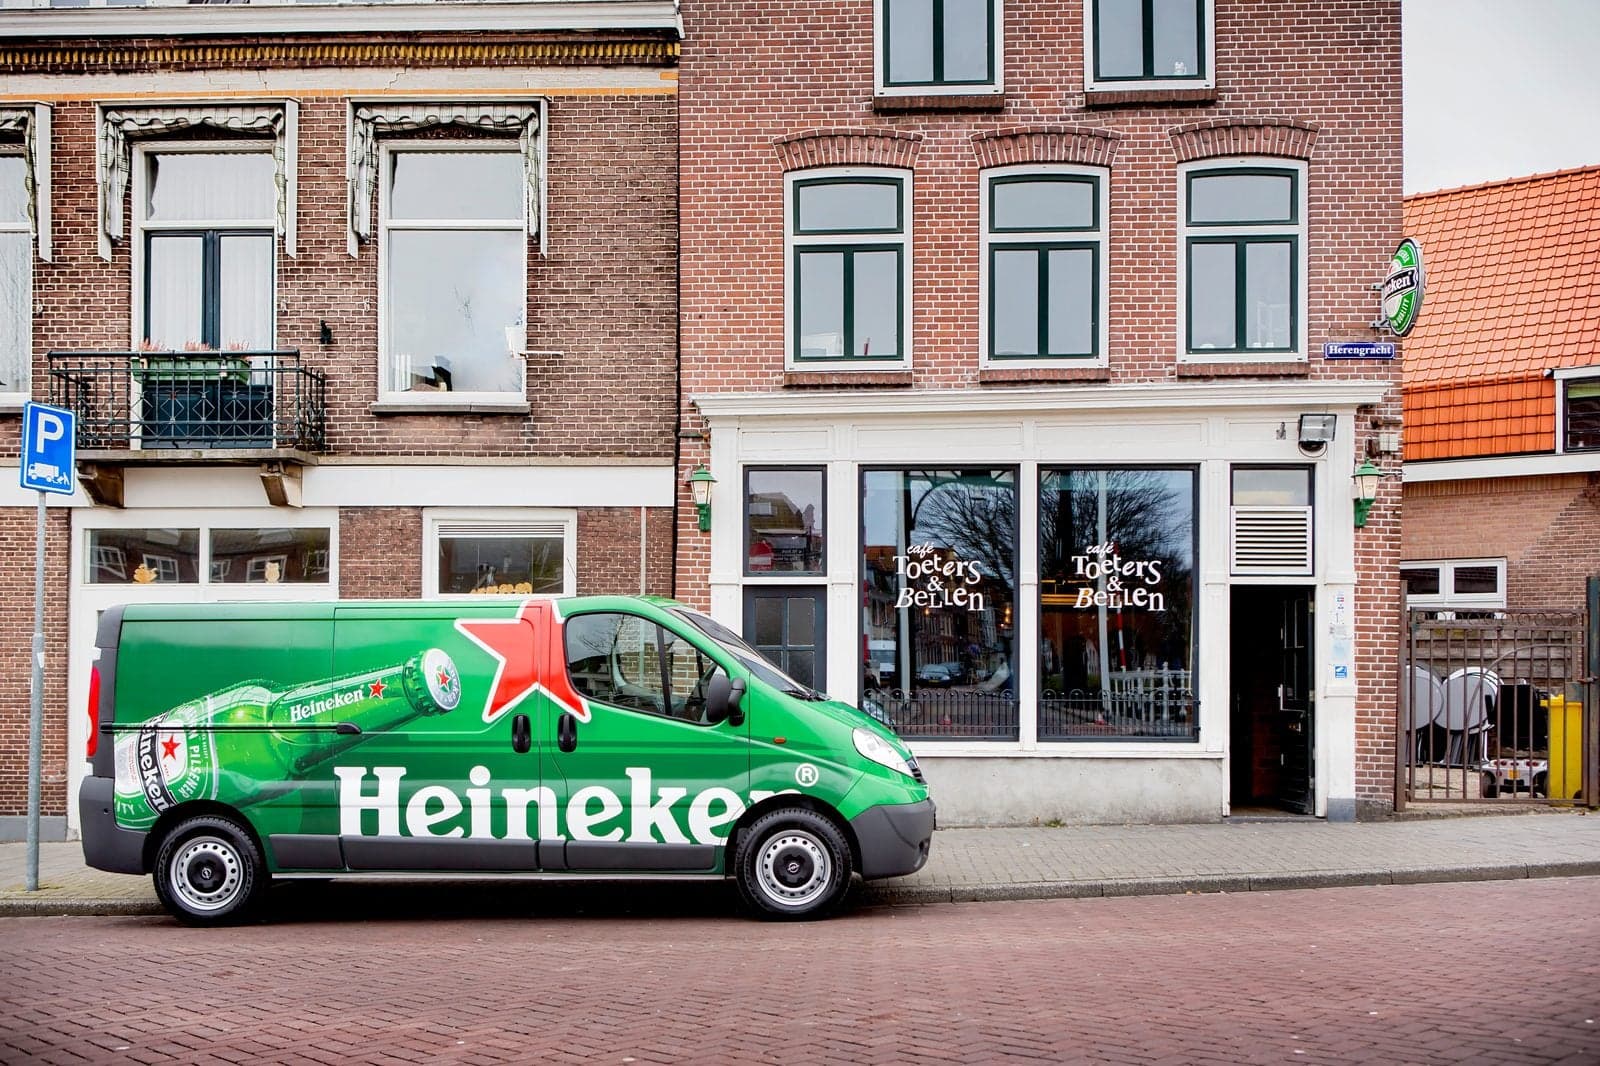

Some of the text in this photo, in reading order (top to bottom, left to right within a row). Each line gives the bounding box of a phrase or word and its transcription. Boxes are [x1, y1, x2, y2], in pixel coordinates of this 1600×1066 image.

[1328, 345, 1391, 357] Herengracht
[36, 412, 64, 453] P
[907, 541, 935, 559] café
[1086, 541, 1114, 559] café
[927, 576, 945, 592] &
[1106, 576, 1125, 592] &
[288, 688, 364, 723] Heineken
[178, 744, 202, 799] PILSENER
[333, 764, 802, 846] Heineke
